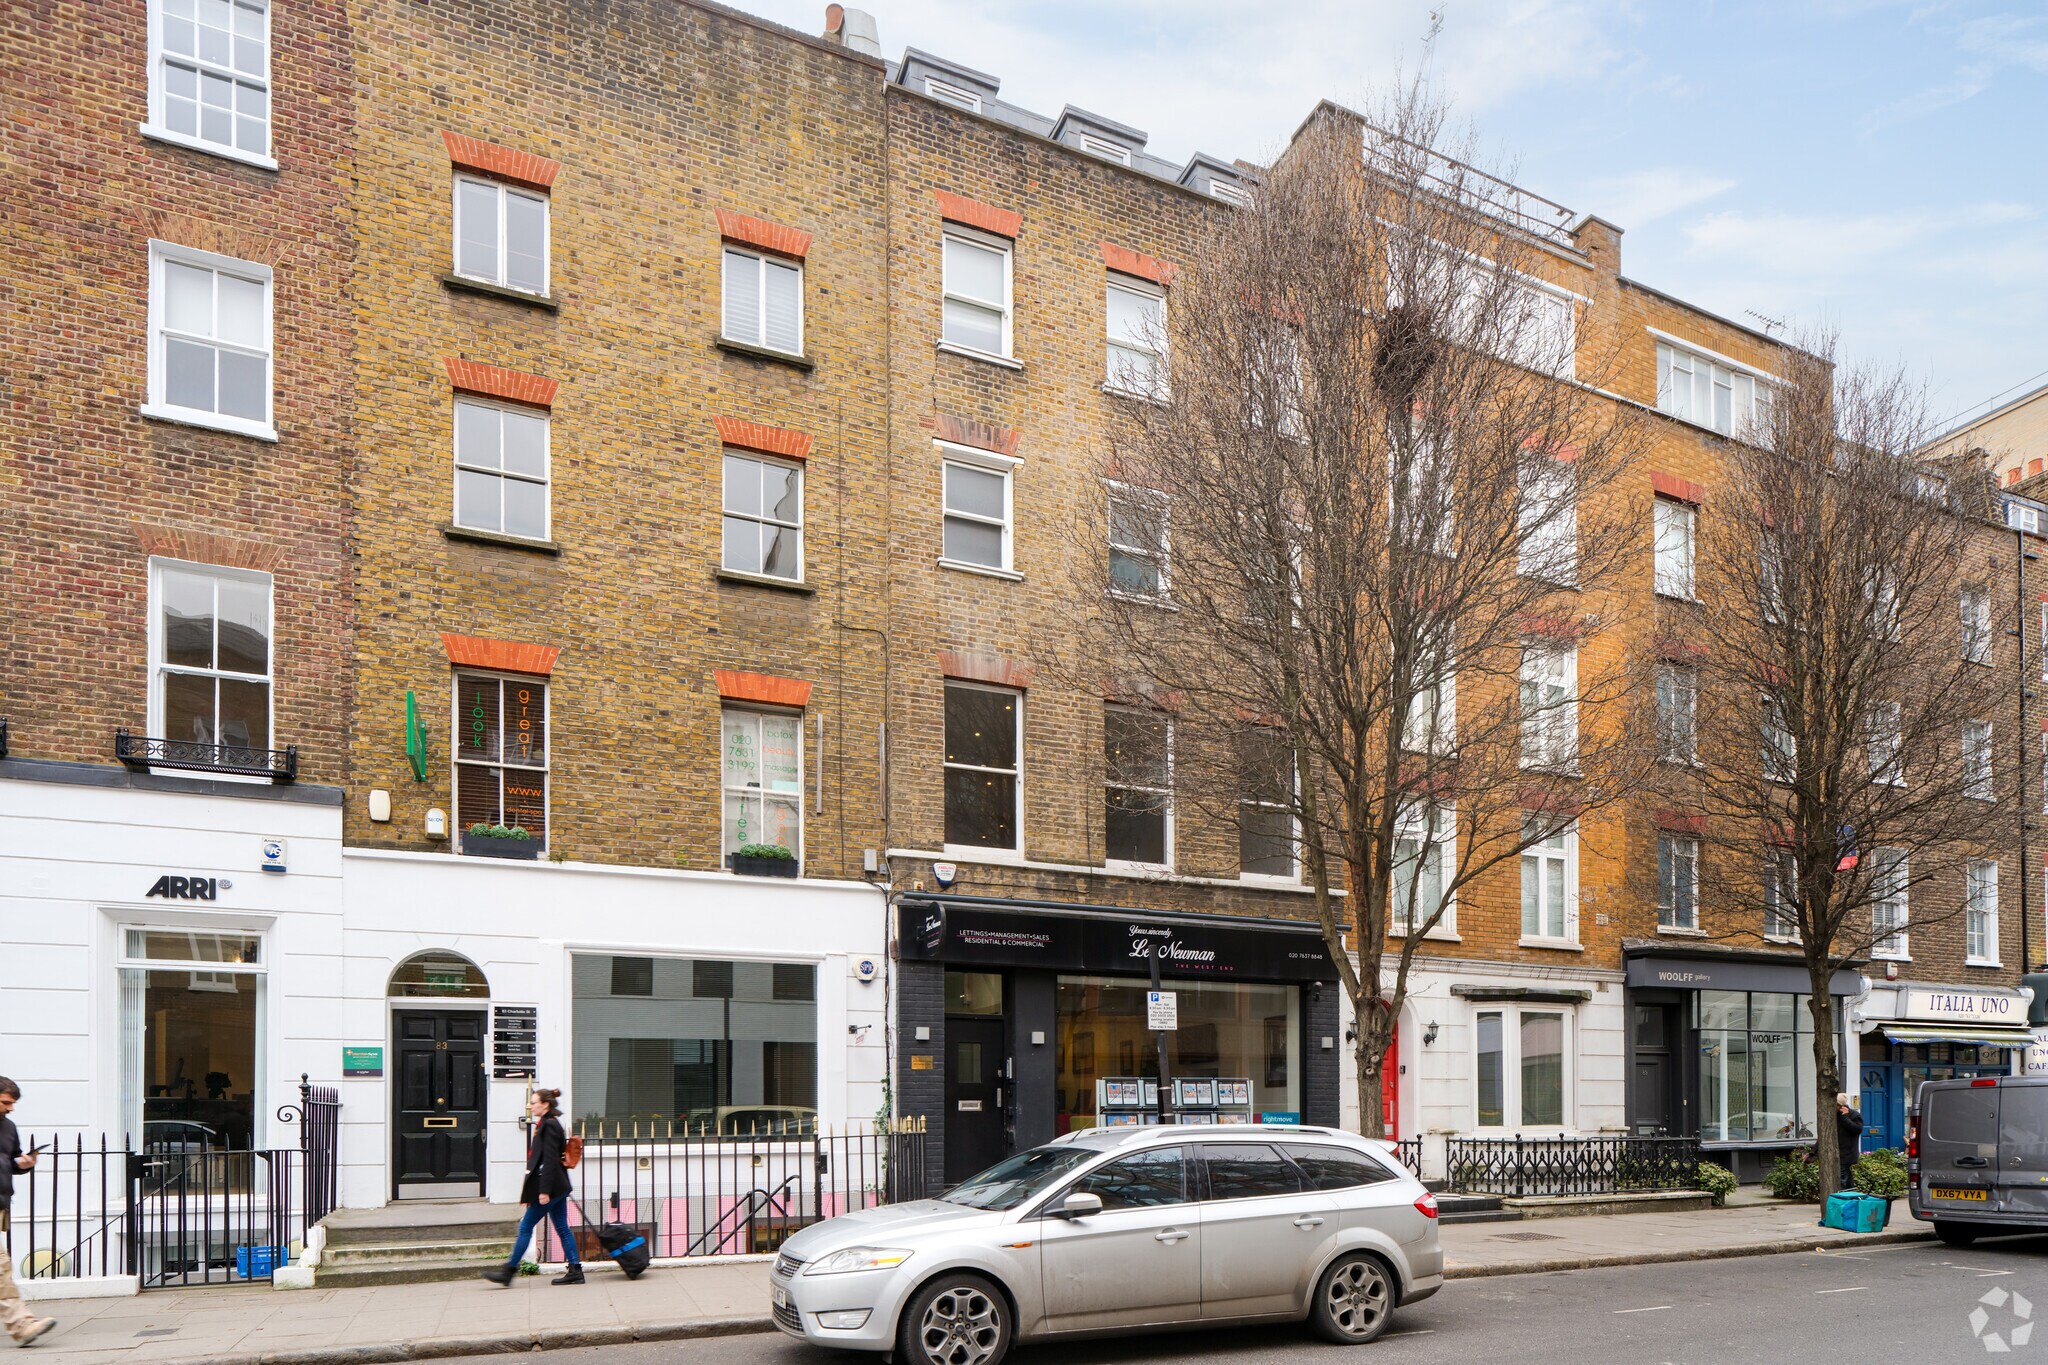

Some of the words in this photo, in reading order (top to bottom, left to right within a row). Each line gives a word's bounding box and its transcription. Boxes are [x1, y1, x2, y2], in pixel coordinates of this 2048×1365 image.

[473, 691, 484, 747] look
[518, 689, 530, 759] great
[731, 734, 752, 745] 020
[145, 876, 217, 900] ARRI
[965, 937, 1001, 946] RESIDENTIAL
[1007, 940, 1045, 948] COMMERCIAL
[1158, 941, 1216, 961] Newman
[1658, 971, 1694, 981] WOOLFF
[1930, 994, 1974, 1012] ITALIA
[1981, 997, 2009, 1013] UNO
[1752, 1034, 1781, 1043] WOOLFF
[436, 1041, 448, 1049] 83
[2028, 1062, 2048, 1070] CAF
[1263, 1115, 1293, 1124] rightmove
[1936, 1189, 1961, 1199] DX67
[1963, 1190, 1982, 1199] VYA
